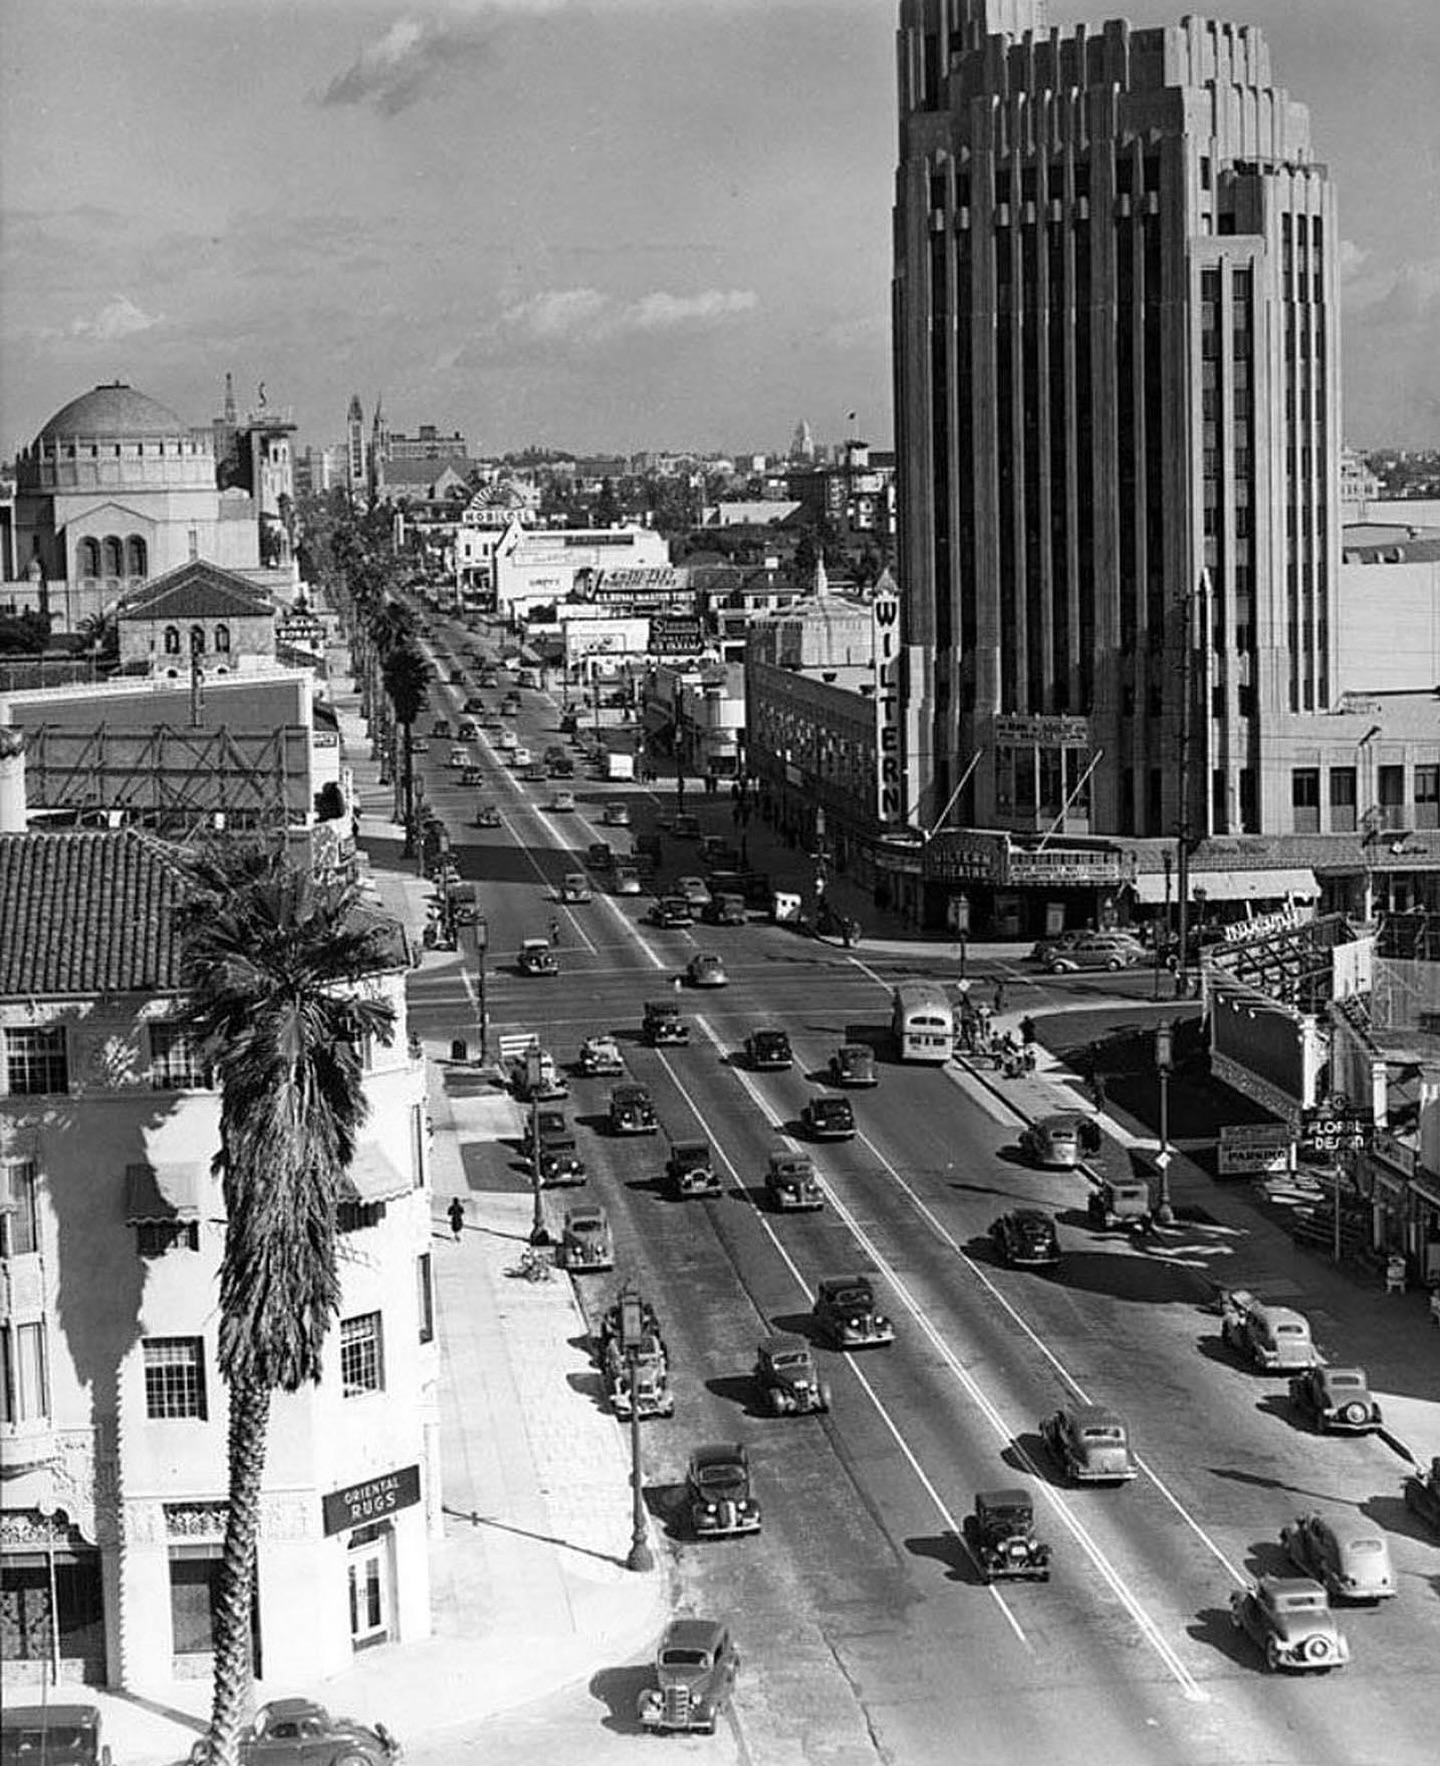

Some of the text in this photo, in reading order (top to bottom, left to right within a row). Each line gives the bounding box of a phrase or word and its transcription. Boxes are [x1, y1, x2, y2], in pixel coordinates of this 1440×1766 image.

[876, 602, 899, 813] WILTERN
[344, 1477, 399, 1505] ORIENTAL
[352, 1491, 396, 1518] RUGS
